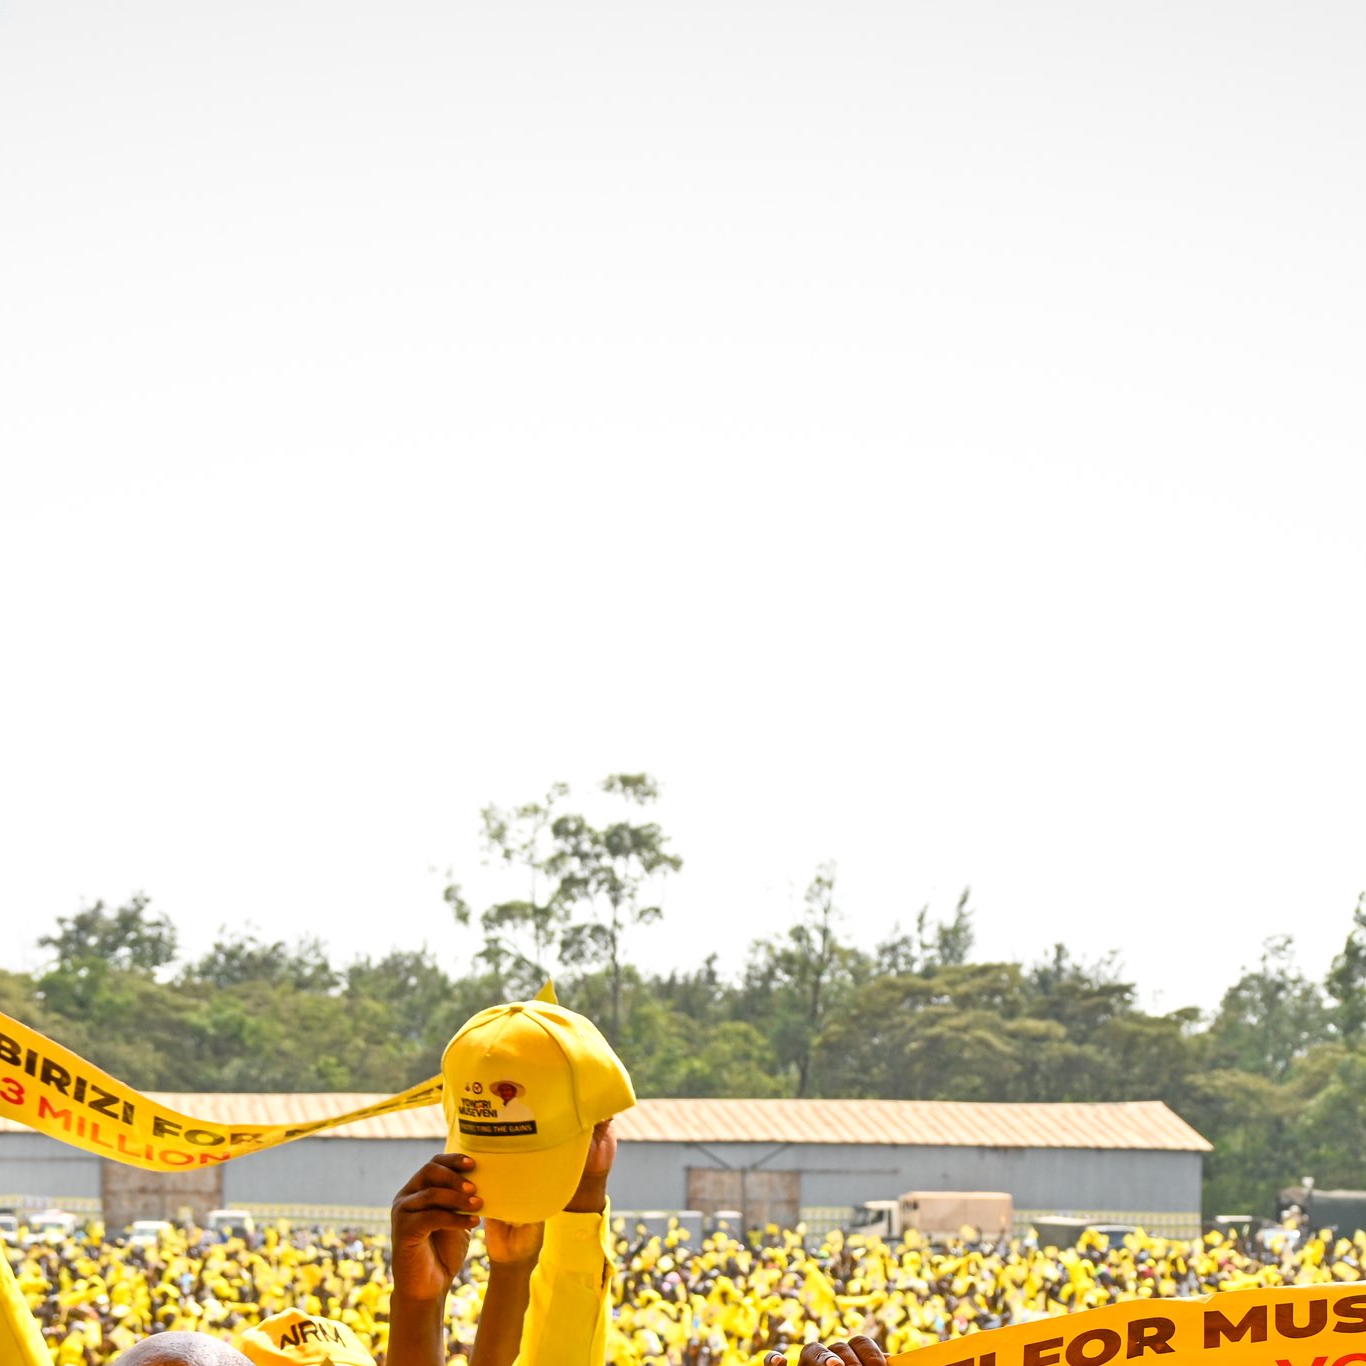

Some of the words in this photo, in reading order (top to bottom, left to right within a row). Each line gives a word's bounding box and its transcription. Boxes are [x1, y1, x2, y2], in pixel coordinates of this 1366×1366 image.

[38, 1096, 231, 1166] MILLION
[153, 1116, 263, 1146] FOR
[508, 1124, 532, 1132] GAINS
[280, 1320, 346, 1350] NRM
